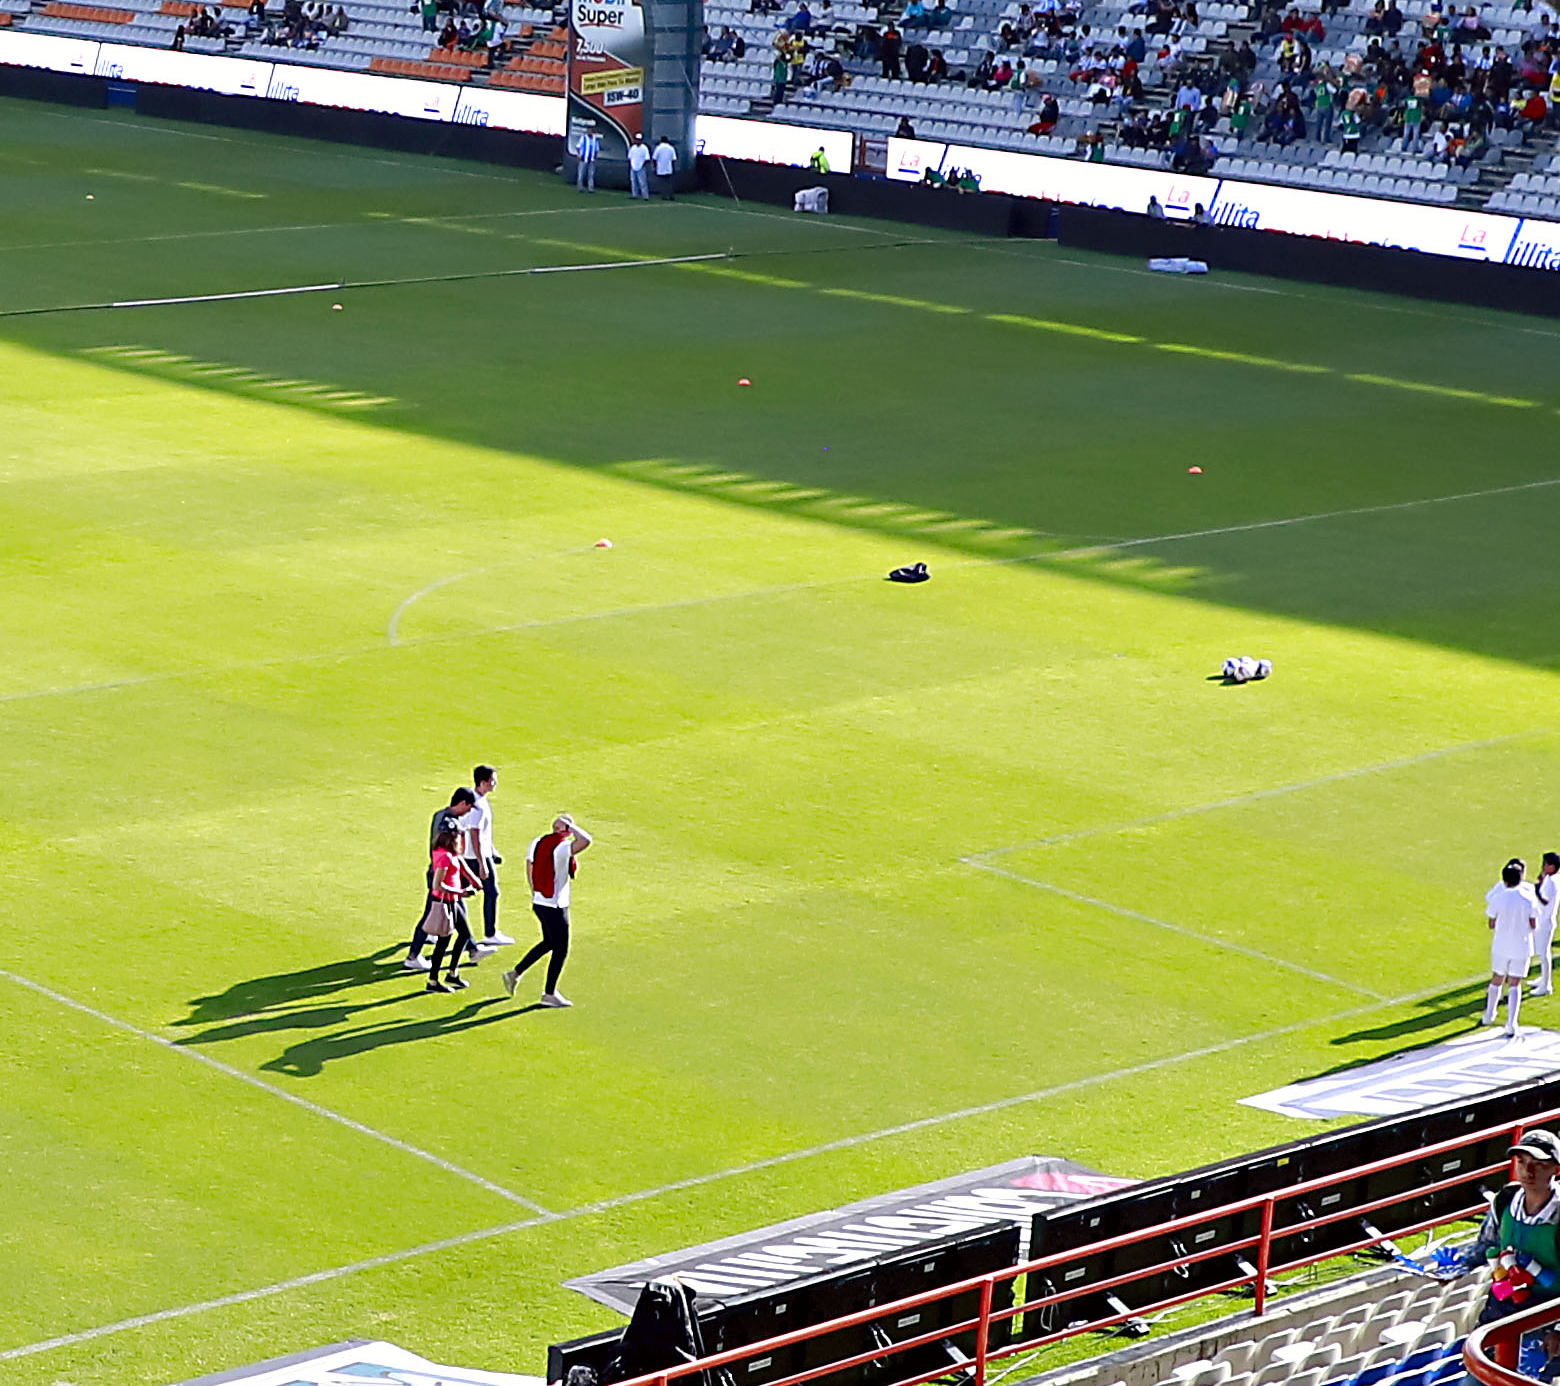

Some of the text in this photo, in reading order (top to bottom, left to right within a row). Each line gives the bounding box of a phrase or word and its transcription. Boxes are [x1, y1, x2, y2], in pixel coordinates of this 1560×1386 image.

[576, 5, 624, 26] Super
[575, 38, 605, 55] 7,500
[1166, 185, 1191, 204] La
[1459, 223, 1487, 244] La
